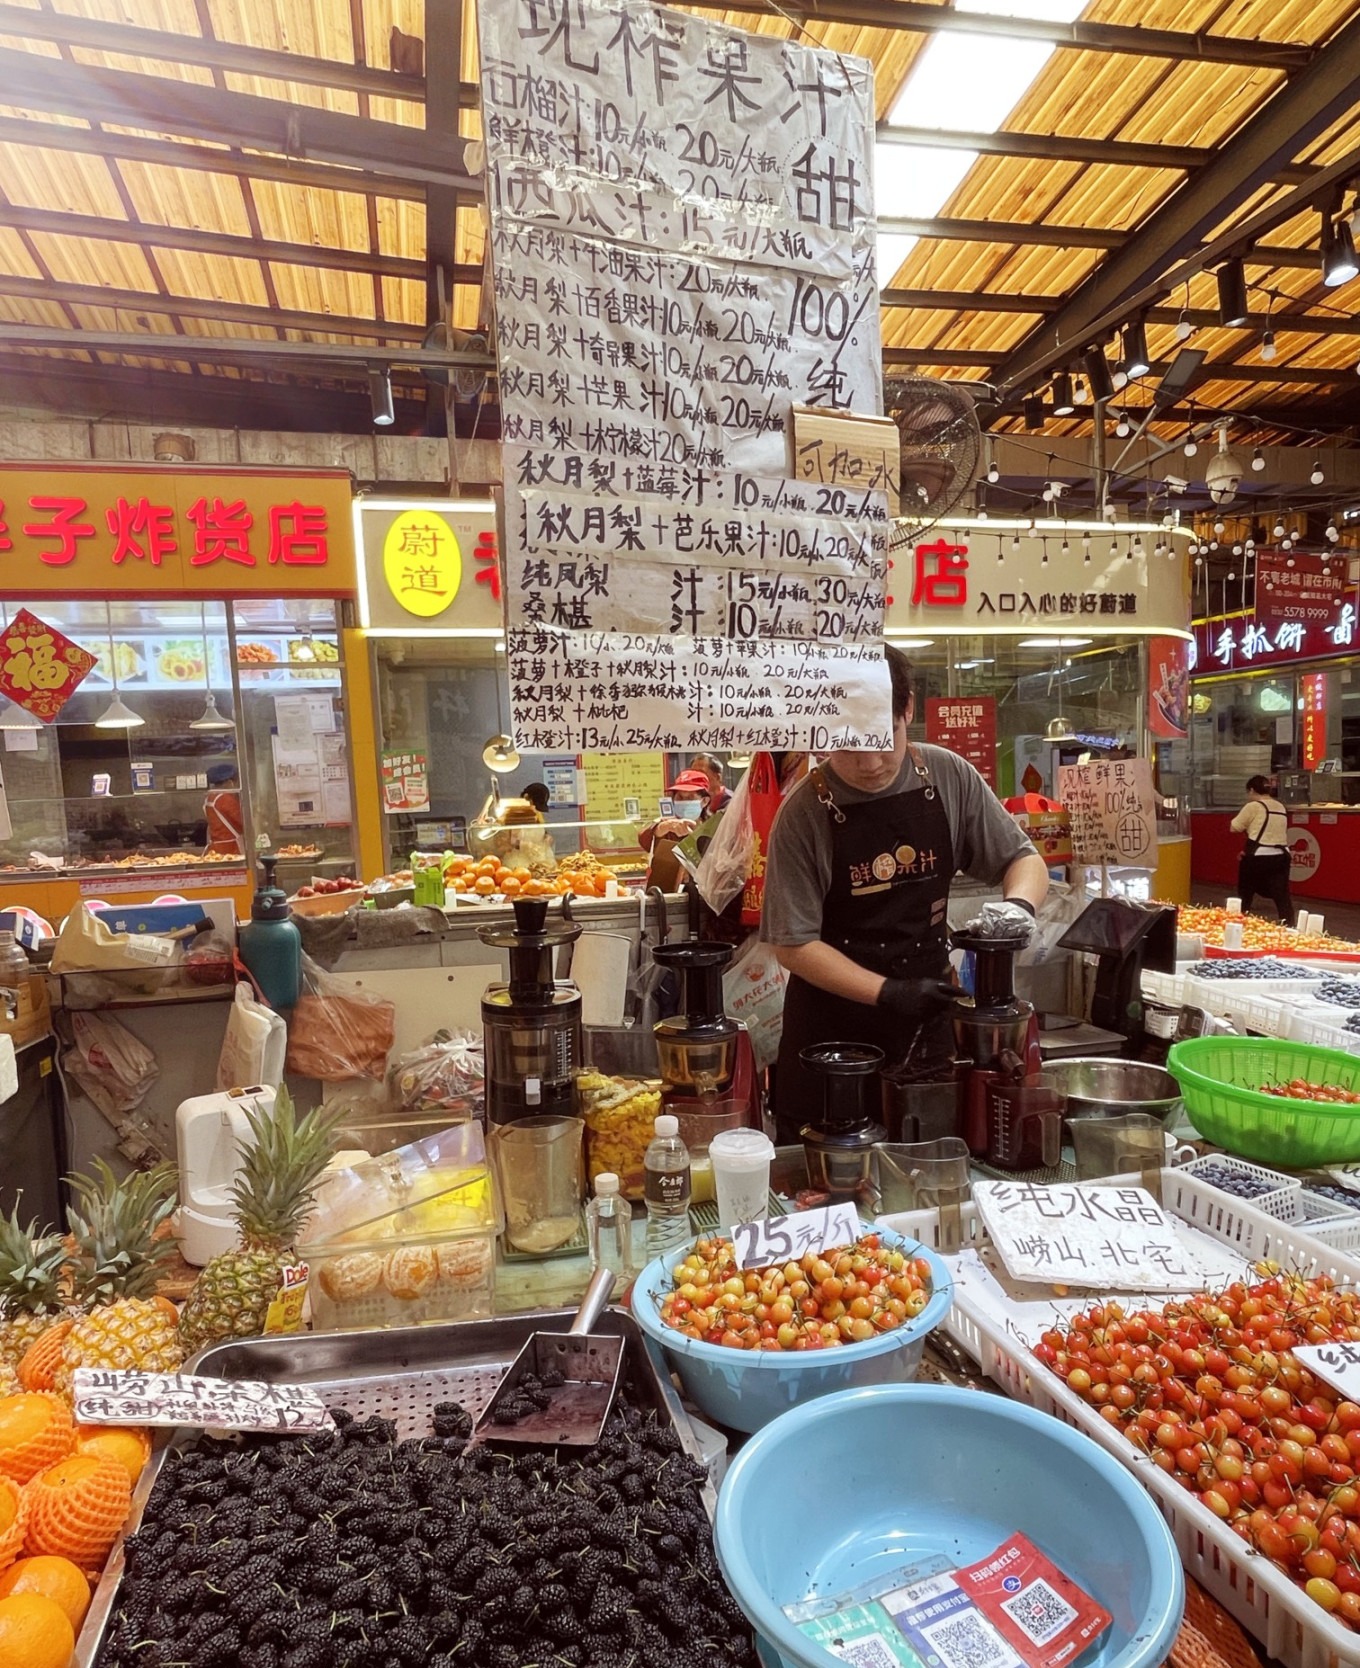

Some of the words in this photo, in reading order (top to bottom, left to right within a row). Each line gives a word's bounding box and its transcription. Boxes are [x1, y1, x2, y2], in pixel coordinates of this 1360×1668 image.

[792, 142, 861, 232] 甜
[788, 276, 874, 363] 100%
[805, 357, 855, 410] 纯
[0, 496, 328, 567] 子炸货店
[976, 592, 1138, 615] 入口入心的好蔚道
[3, 633, 70, 691] 福
[1213, 622, 1307, 665] 手抓饼
[1119, 818, 1143, 852] 甜
[989, 1181, 1164, 1226] 纯水晶
